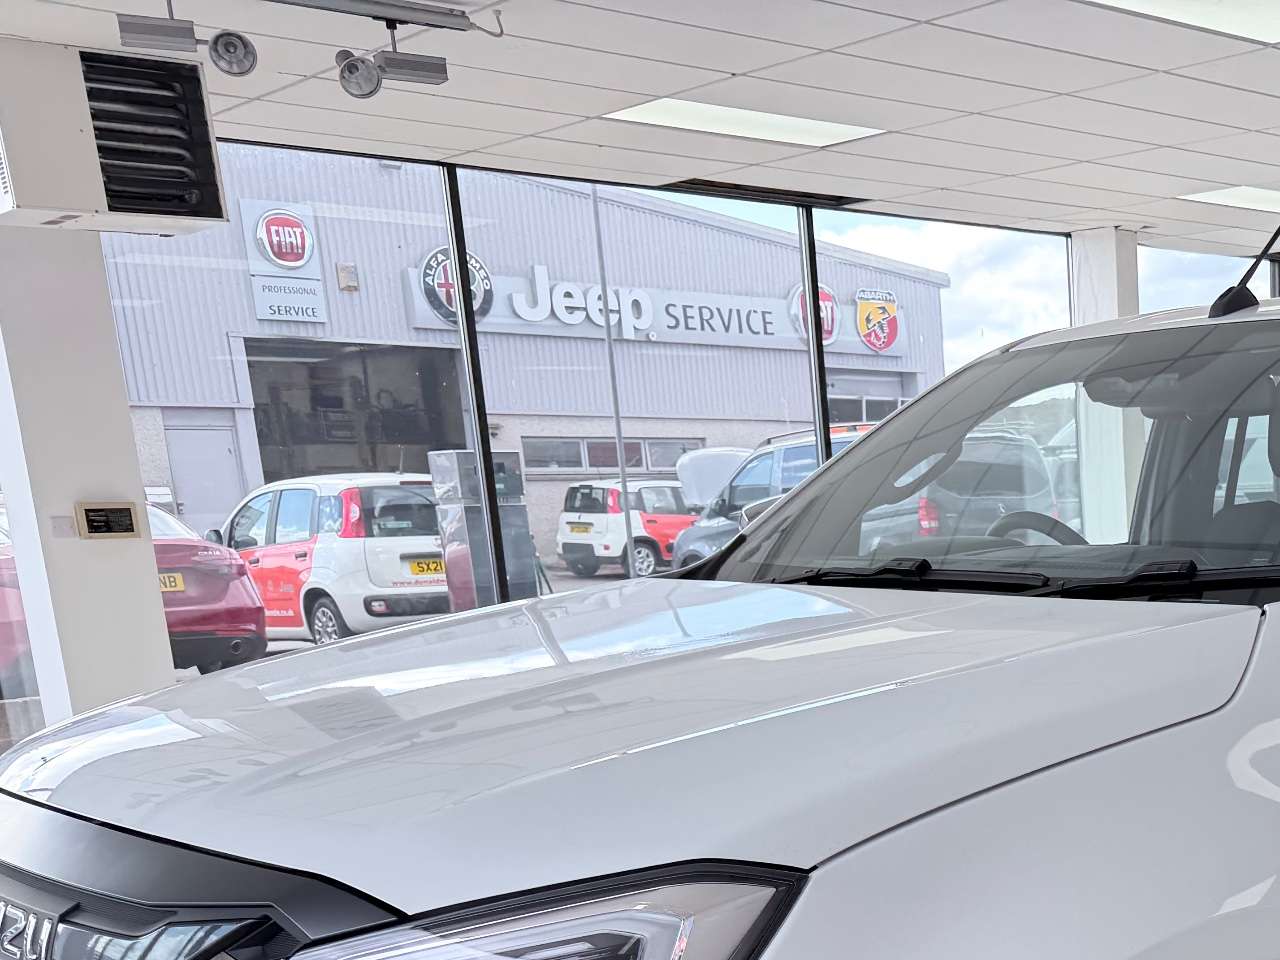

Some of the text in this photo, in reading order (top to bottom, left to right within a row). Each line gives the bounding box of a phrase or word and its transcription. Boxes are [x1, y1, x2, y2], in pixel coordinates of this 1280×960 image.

[270, 225, 303, 254] FIAT
[424, 253, 447, 286] ALFA
[261, 284, 318, 297] PROFESSIONAL
[268, 304, 319, 318] SERVICE
[511, 264, 775, 340] Jeep SERVICE
[159, 575, 177, 589] NB
